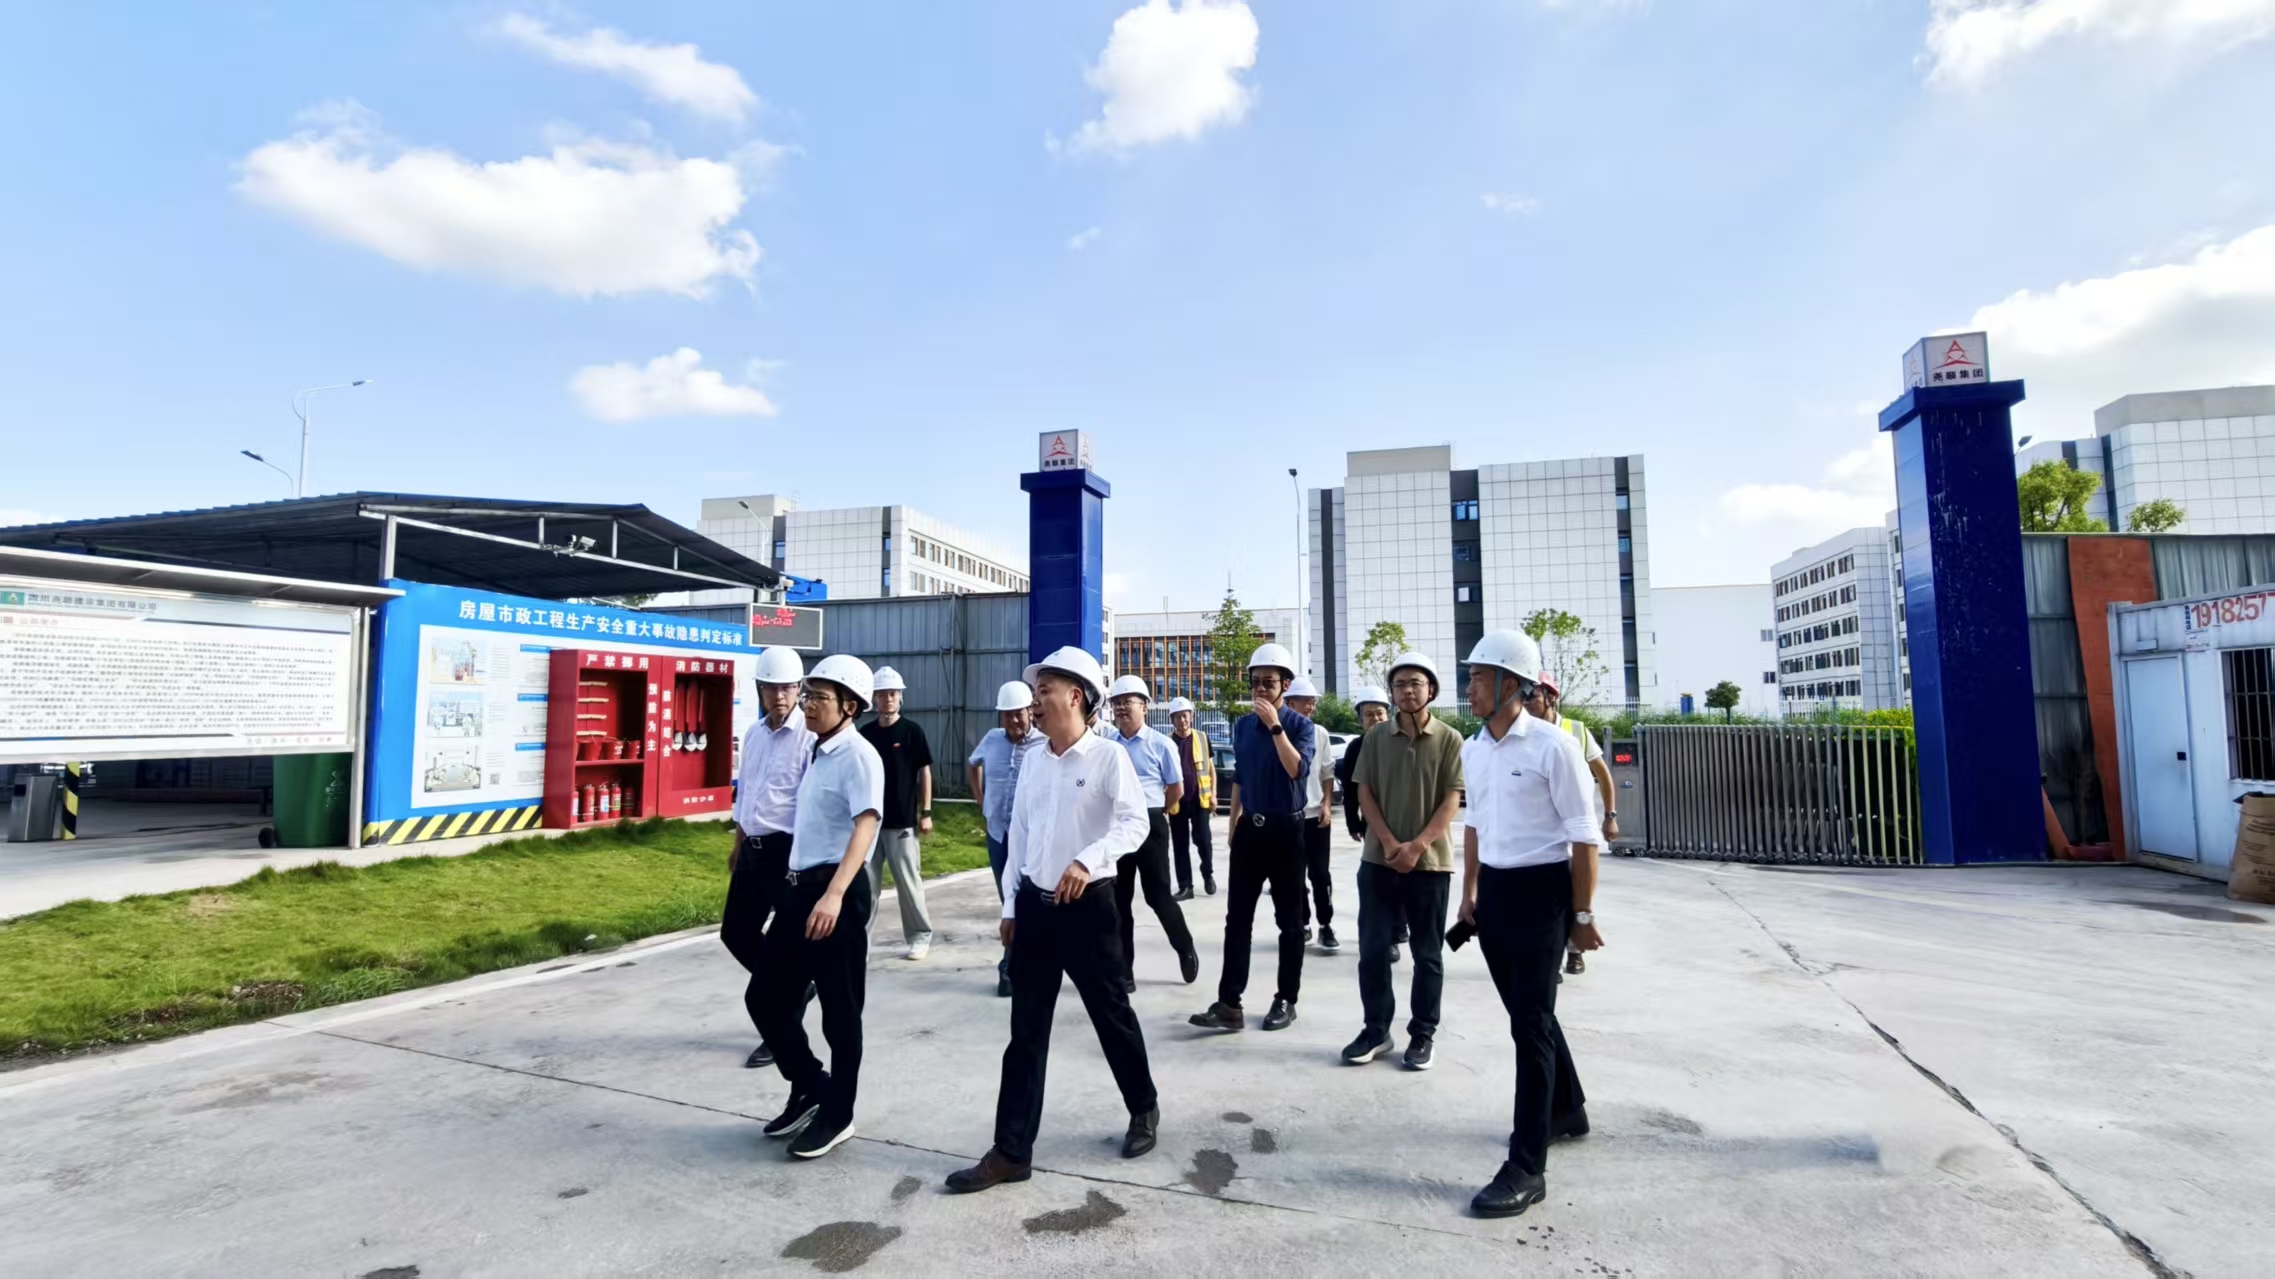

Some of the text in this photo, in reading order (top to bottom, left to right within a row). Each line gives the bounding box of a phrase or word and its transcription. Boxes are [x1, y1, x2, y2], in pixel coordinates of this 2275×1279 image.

[1933, 368, 1984, 381] 尧顺集团
[2191, 592, 2275, 628] 1918257
[459, 599, 743, 646] 房屋市政工程生产安全重大事故隐患判定标准
[676, 660, 729, 673] 消防器材
